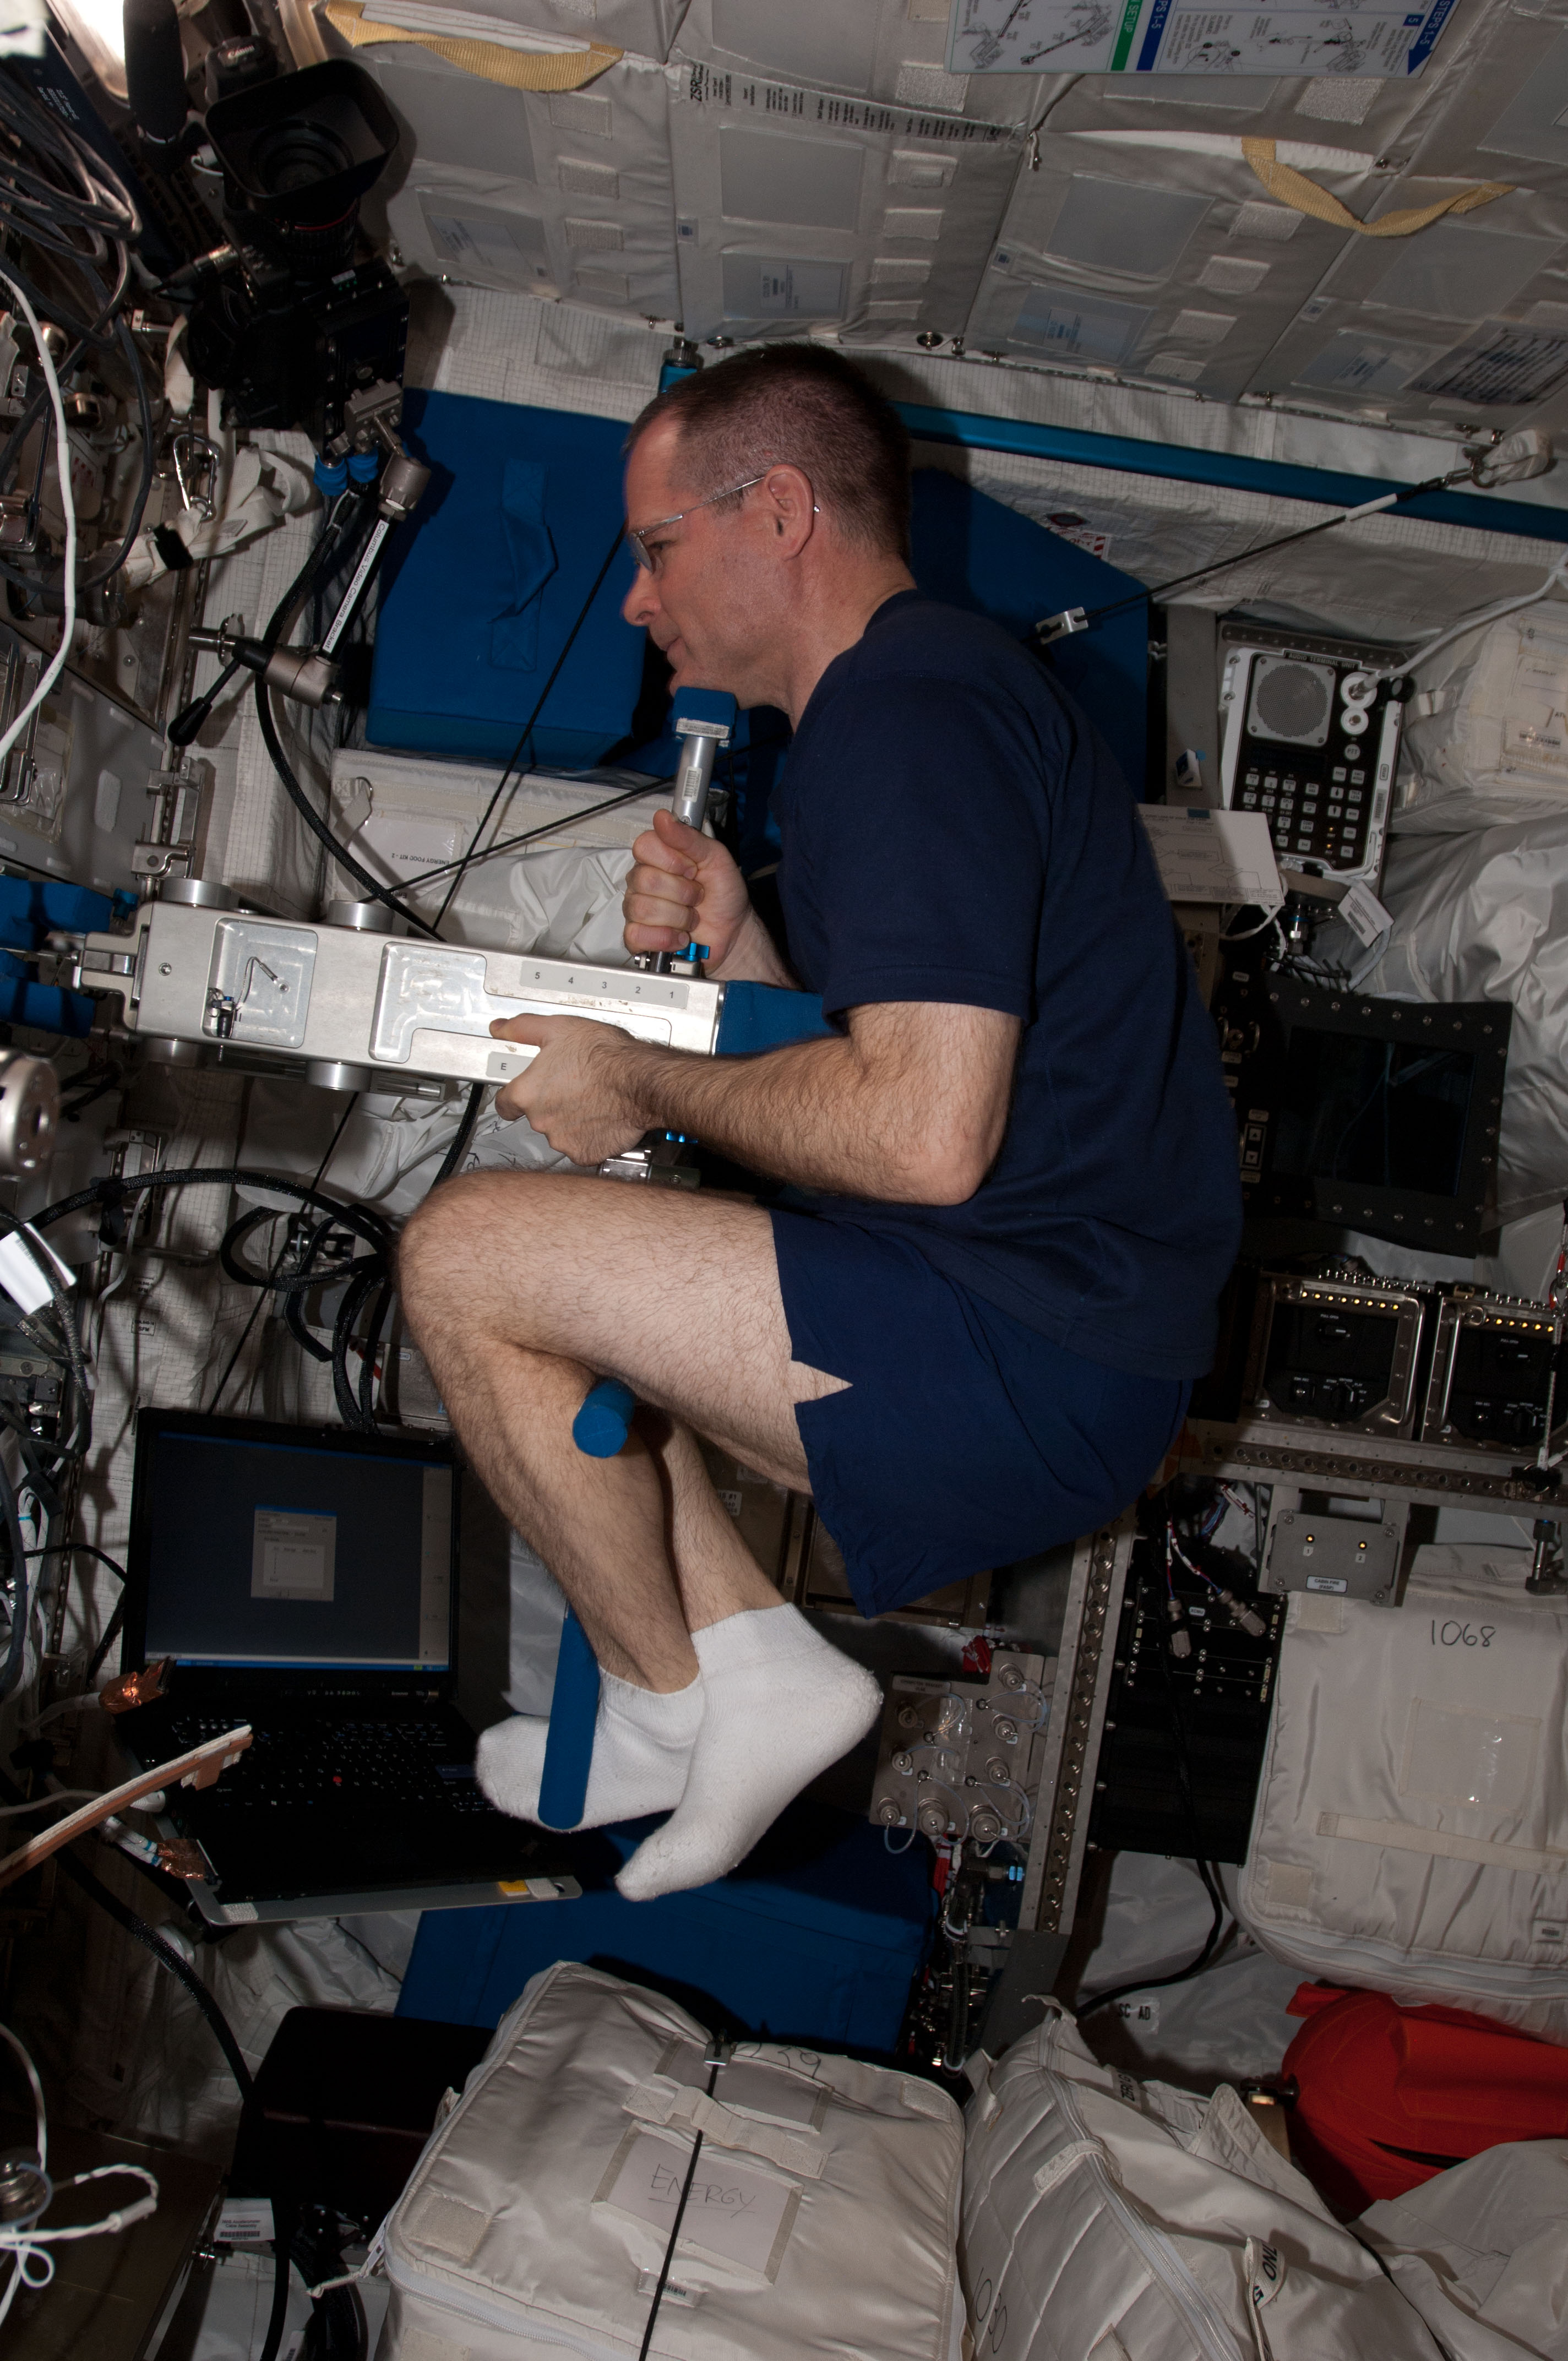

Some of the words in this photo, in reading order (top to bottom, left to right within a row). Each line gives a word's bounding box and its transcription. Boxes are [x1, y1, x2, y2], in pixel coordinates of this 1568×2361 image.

[1124, 4, 1140, 33] SETUP
[1428, 1, 1451, 28] STEPS
[690, 79, 702, 102] ZSR
[364, 523, 385, 564] Columbus
[354, 564, 368, 586] Video
[340, 587, 357, 617] Camera
[325, 618, 342, 650] Bracket
[1310, 656, 1339, 666] TERMINAL
[1432, 1619, 1496, 1647] 1068
[1118, 2003, 1130, 2019] SC
[1138, 2006, 1151, 2020] AD
[650, 2163, 756, 2218] ENERGY
[1262, 2243, 1277, 2281] ONL
